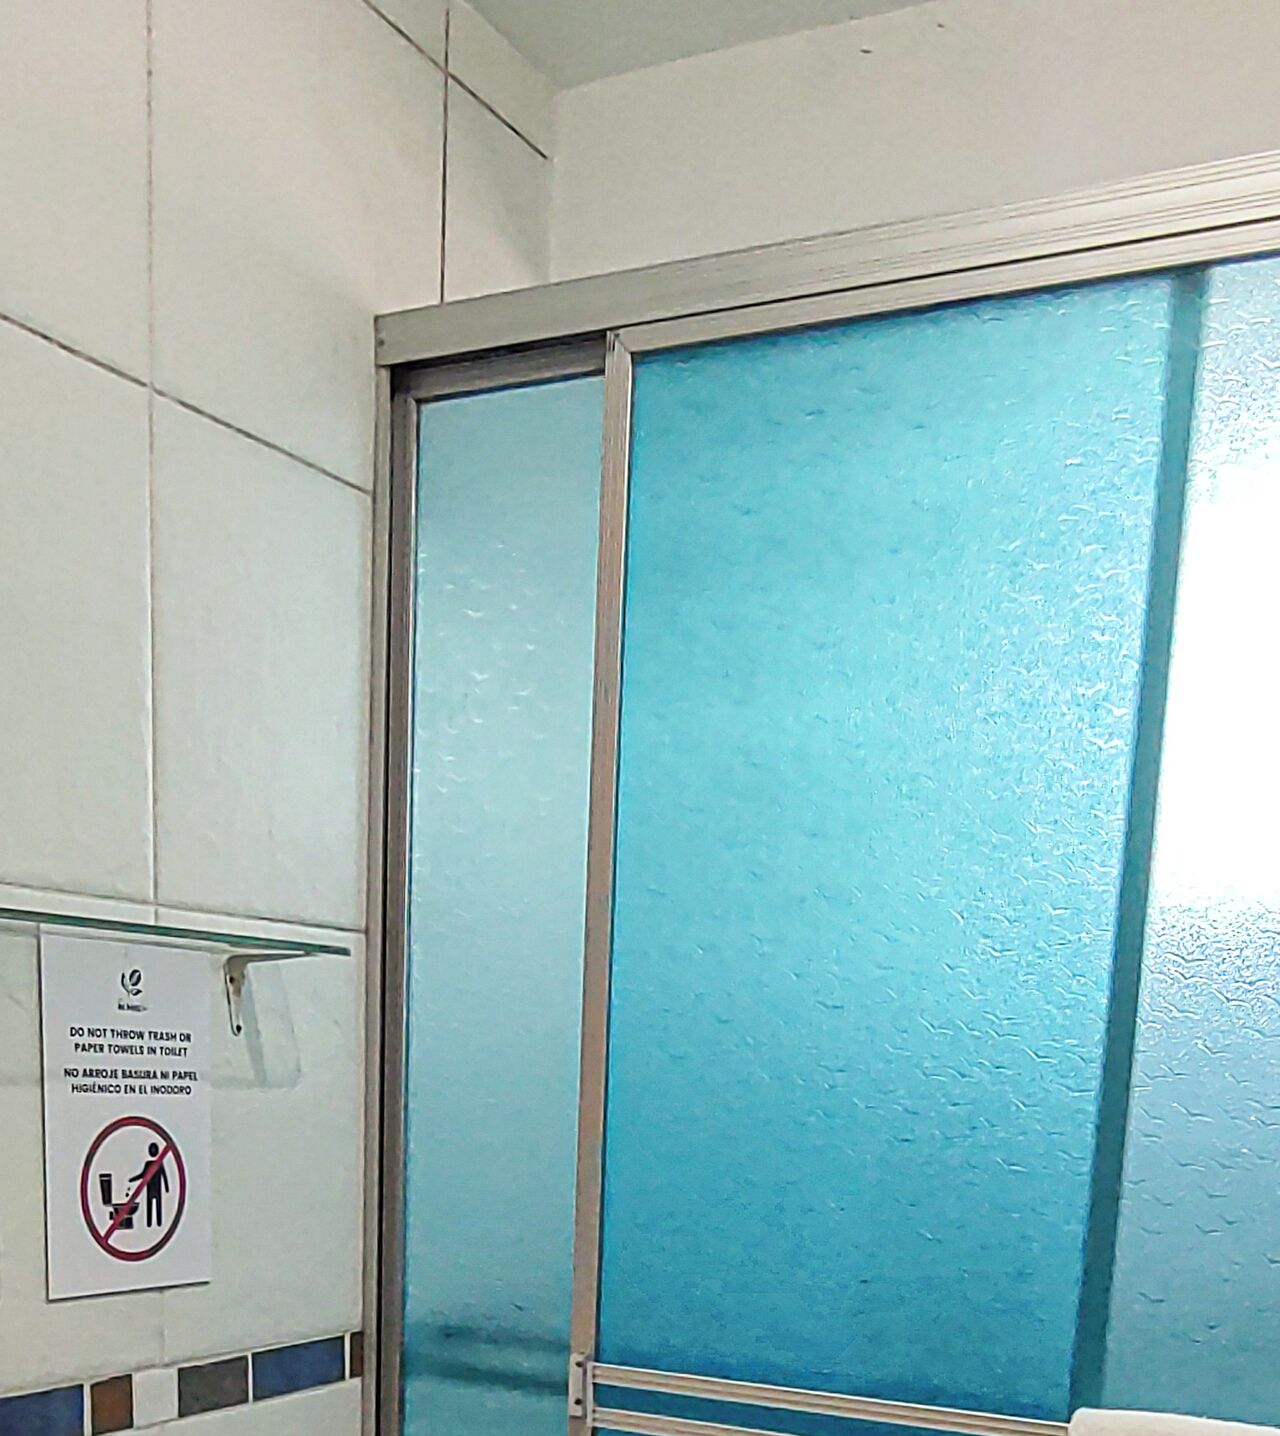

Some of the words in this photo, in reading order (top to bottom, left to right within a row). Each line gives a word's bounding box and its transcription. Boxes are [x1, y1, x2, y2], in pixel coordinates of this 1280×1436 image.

[70, 1027, 84, 1037] DO
[88, 1028, 106, 1038] NOT
[110, 1029, 144, 1040] THROW
[148, 1031, 177, 1042] TRASH
[179, 1033, 191, 1043] OR
[74, 1043, 104, 1053] PAPER
[107, 1044, 144, 1055] TOWELS
[147, 1046, 157, 1055] IN
[160, 1047, 187, 1057] TOILET
[64, 1068, 79, 1077] NO
[82, 1068, 118, 1079] ARROJE
[121, 1069, 158, 1079] BASURA
[160, 1070, 169, 1080] NI
[172, 1071, 198, 1081] PAPEL
[71, 1081, 120, 1093] HIGIÉNICO
[124, 1084, 136, 1093] EN
[139, 1085, 148, 1094] EL
[150, 1085, 192, 1095] INODORO
